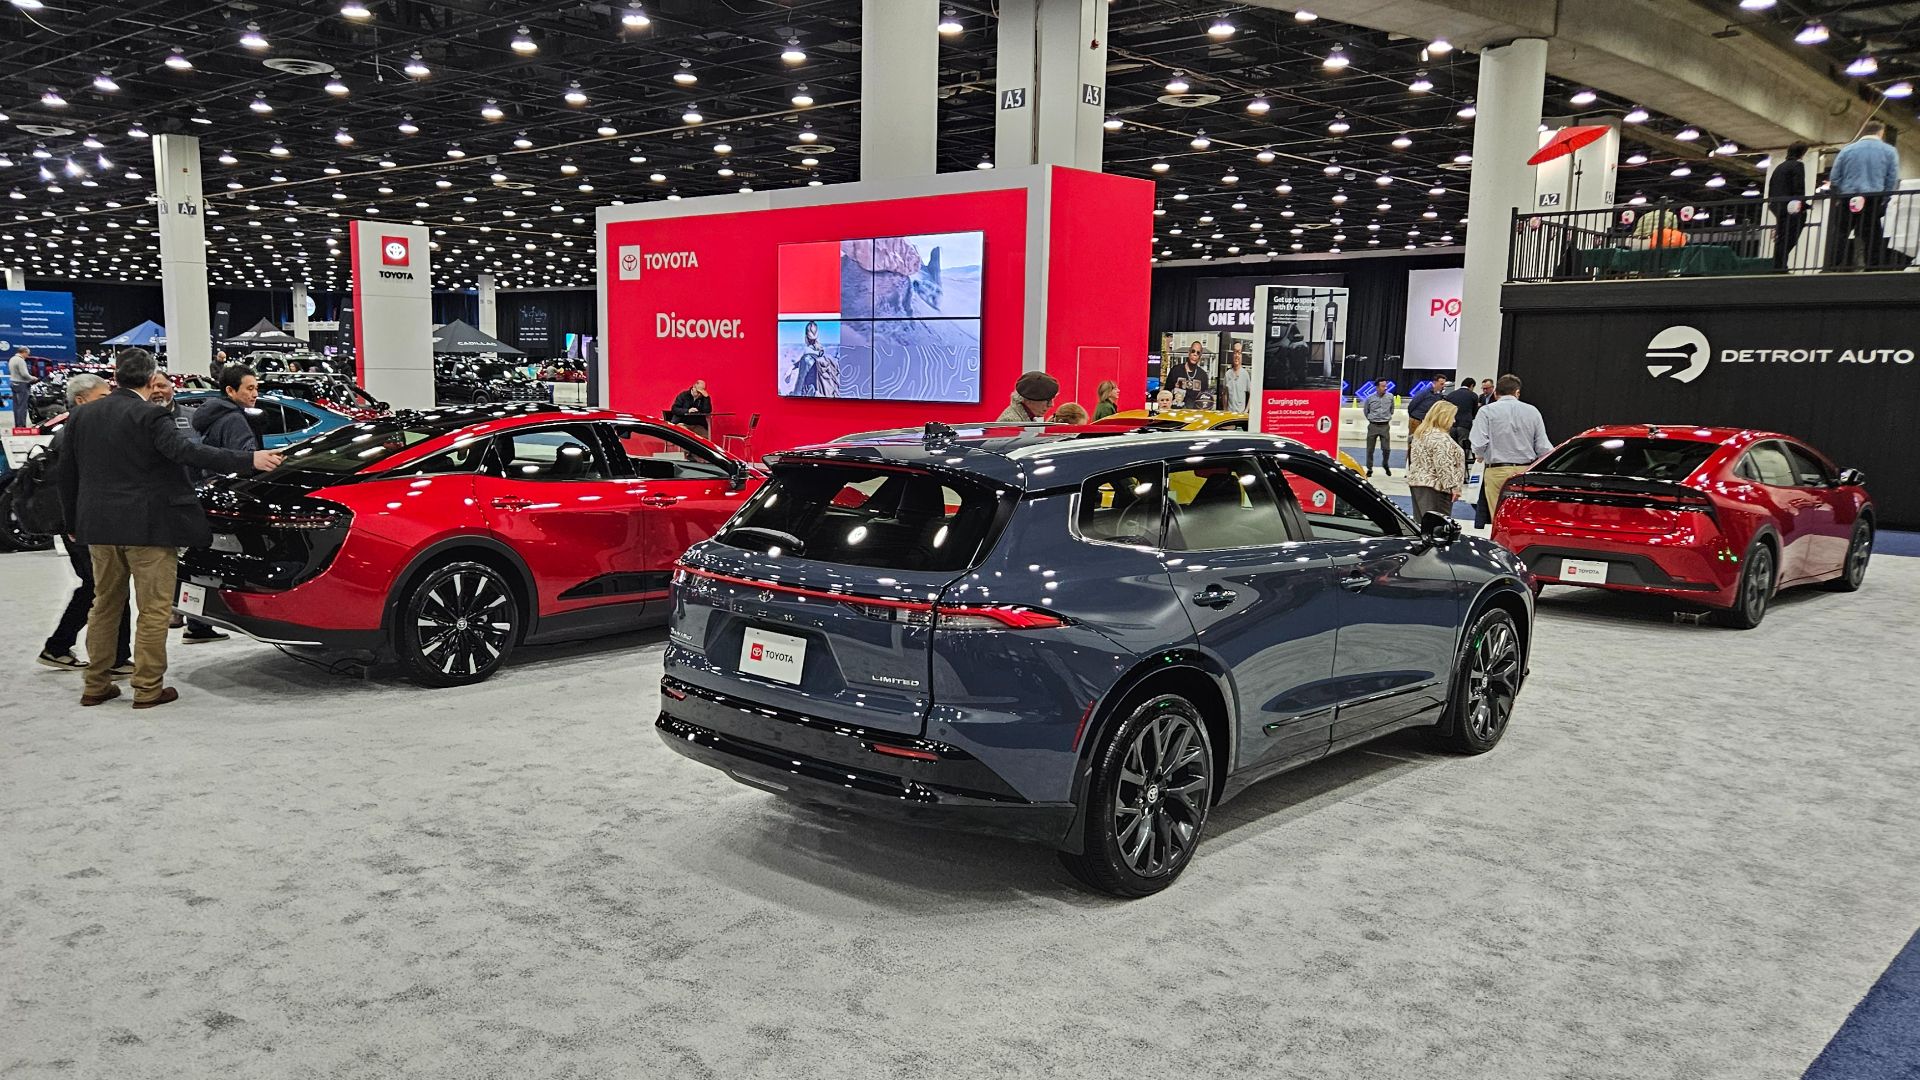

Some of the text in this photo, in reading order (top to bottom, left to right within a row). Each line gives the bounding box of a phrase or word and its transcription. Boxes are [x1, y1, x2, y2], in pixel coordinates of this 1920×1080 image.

[1004, 89, 1022, 109] A3
[1085, 85, 1100, 105] A3
[1541, 193, 1558, 206] A2
[644, 251, 699, 269] TOYOTA
[379, 270, 414, 280] TOYOTA
[1208, 297, 1250, 311] THERE
[1274, 295, 1284, 303] Get
[1300, 297, 1316, 305] speed
[656, 311, 745, 339] Discover.
[1208, 312, 1236, 326] ONE
[1720, 349, 1915, 364] DETROIT AUTO
[1268, 398, 1310, 407] Charging types
[765, 650, 794, 664] TOYOTA
[871, 674, 920, 687] LIMITED
